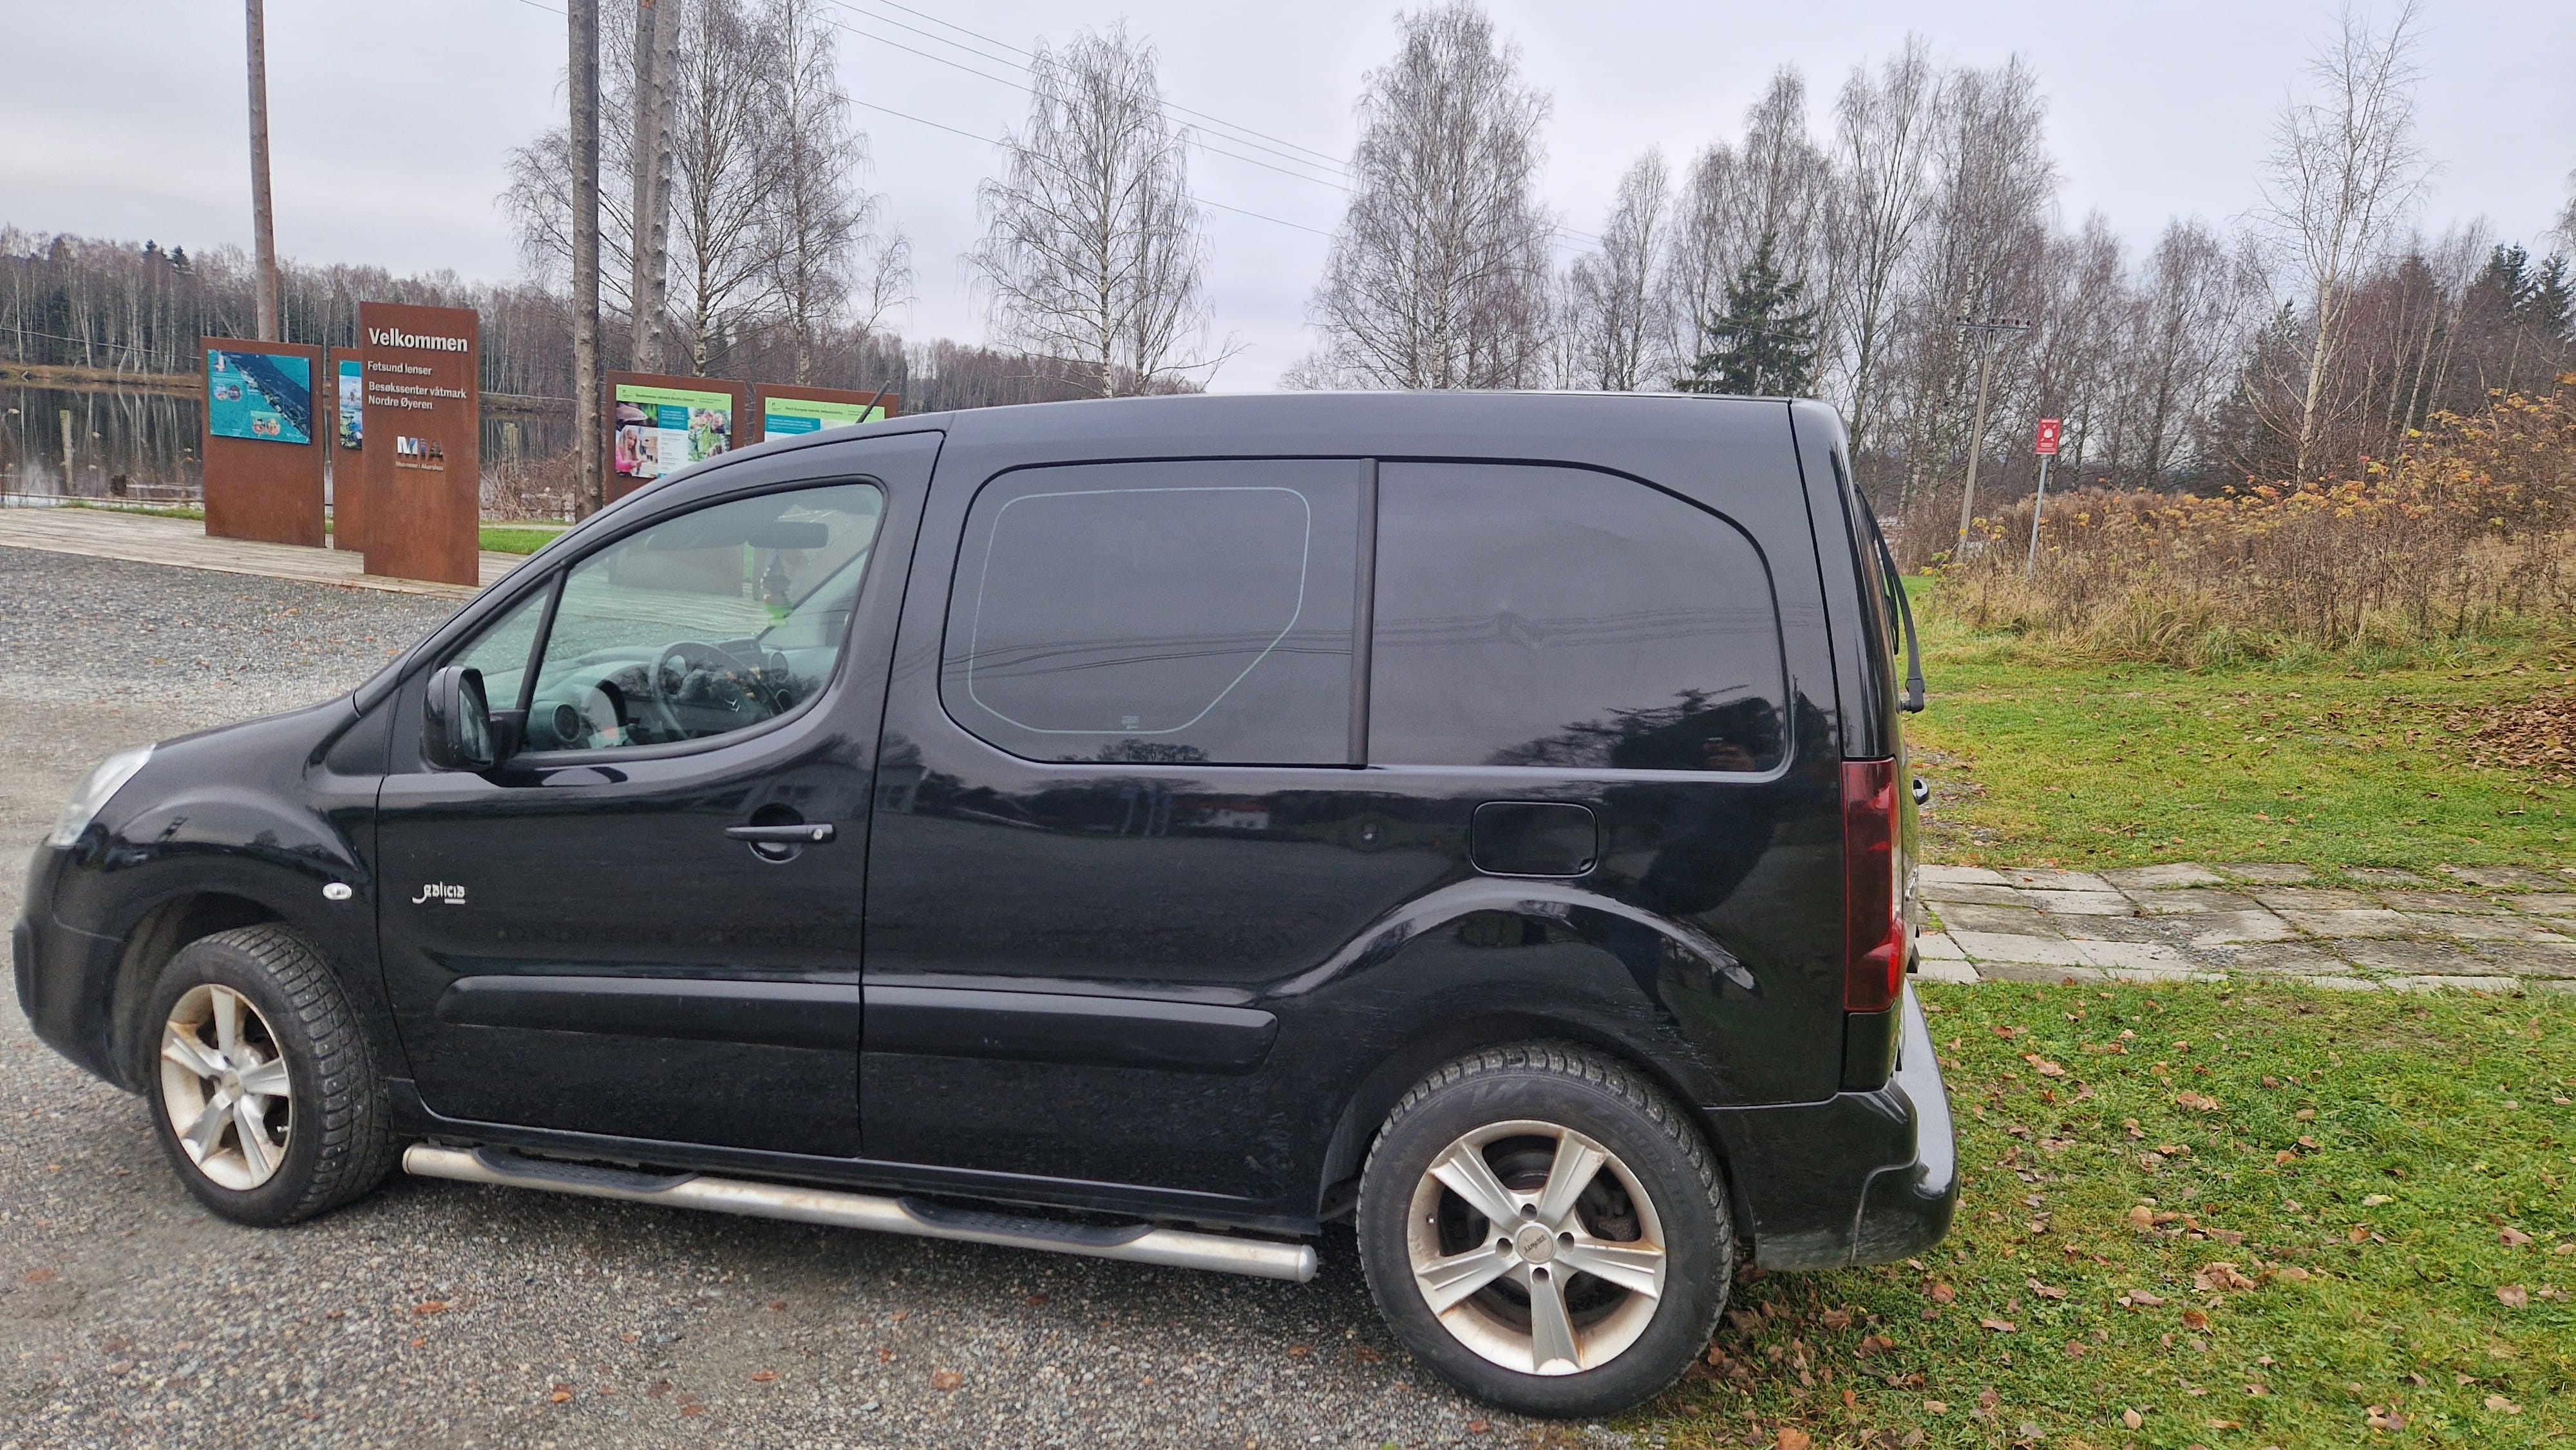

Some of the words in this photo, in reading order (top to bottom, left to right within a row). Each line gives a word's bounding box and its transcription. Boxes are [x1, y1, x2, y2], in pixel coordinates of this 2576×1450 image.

[368, 327, 468, 352] Velkommen
[368, 361, 403, 373] Fetsund
[405, 363, 432, 375] lenser
[369, 381, 428, 395] Besøkssenter
[430, 386, 467, 399] våtmark
[368, 395, 399, 406] Nordre
[401, 397, 433, 410] Øyeren
